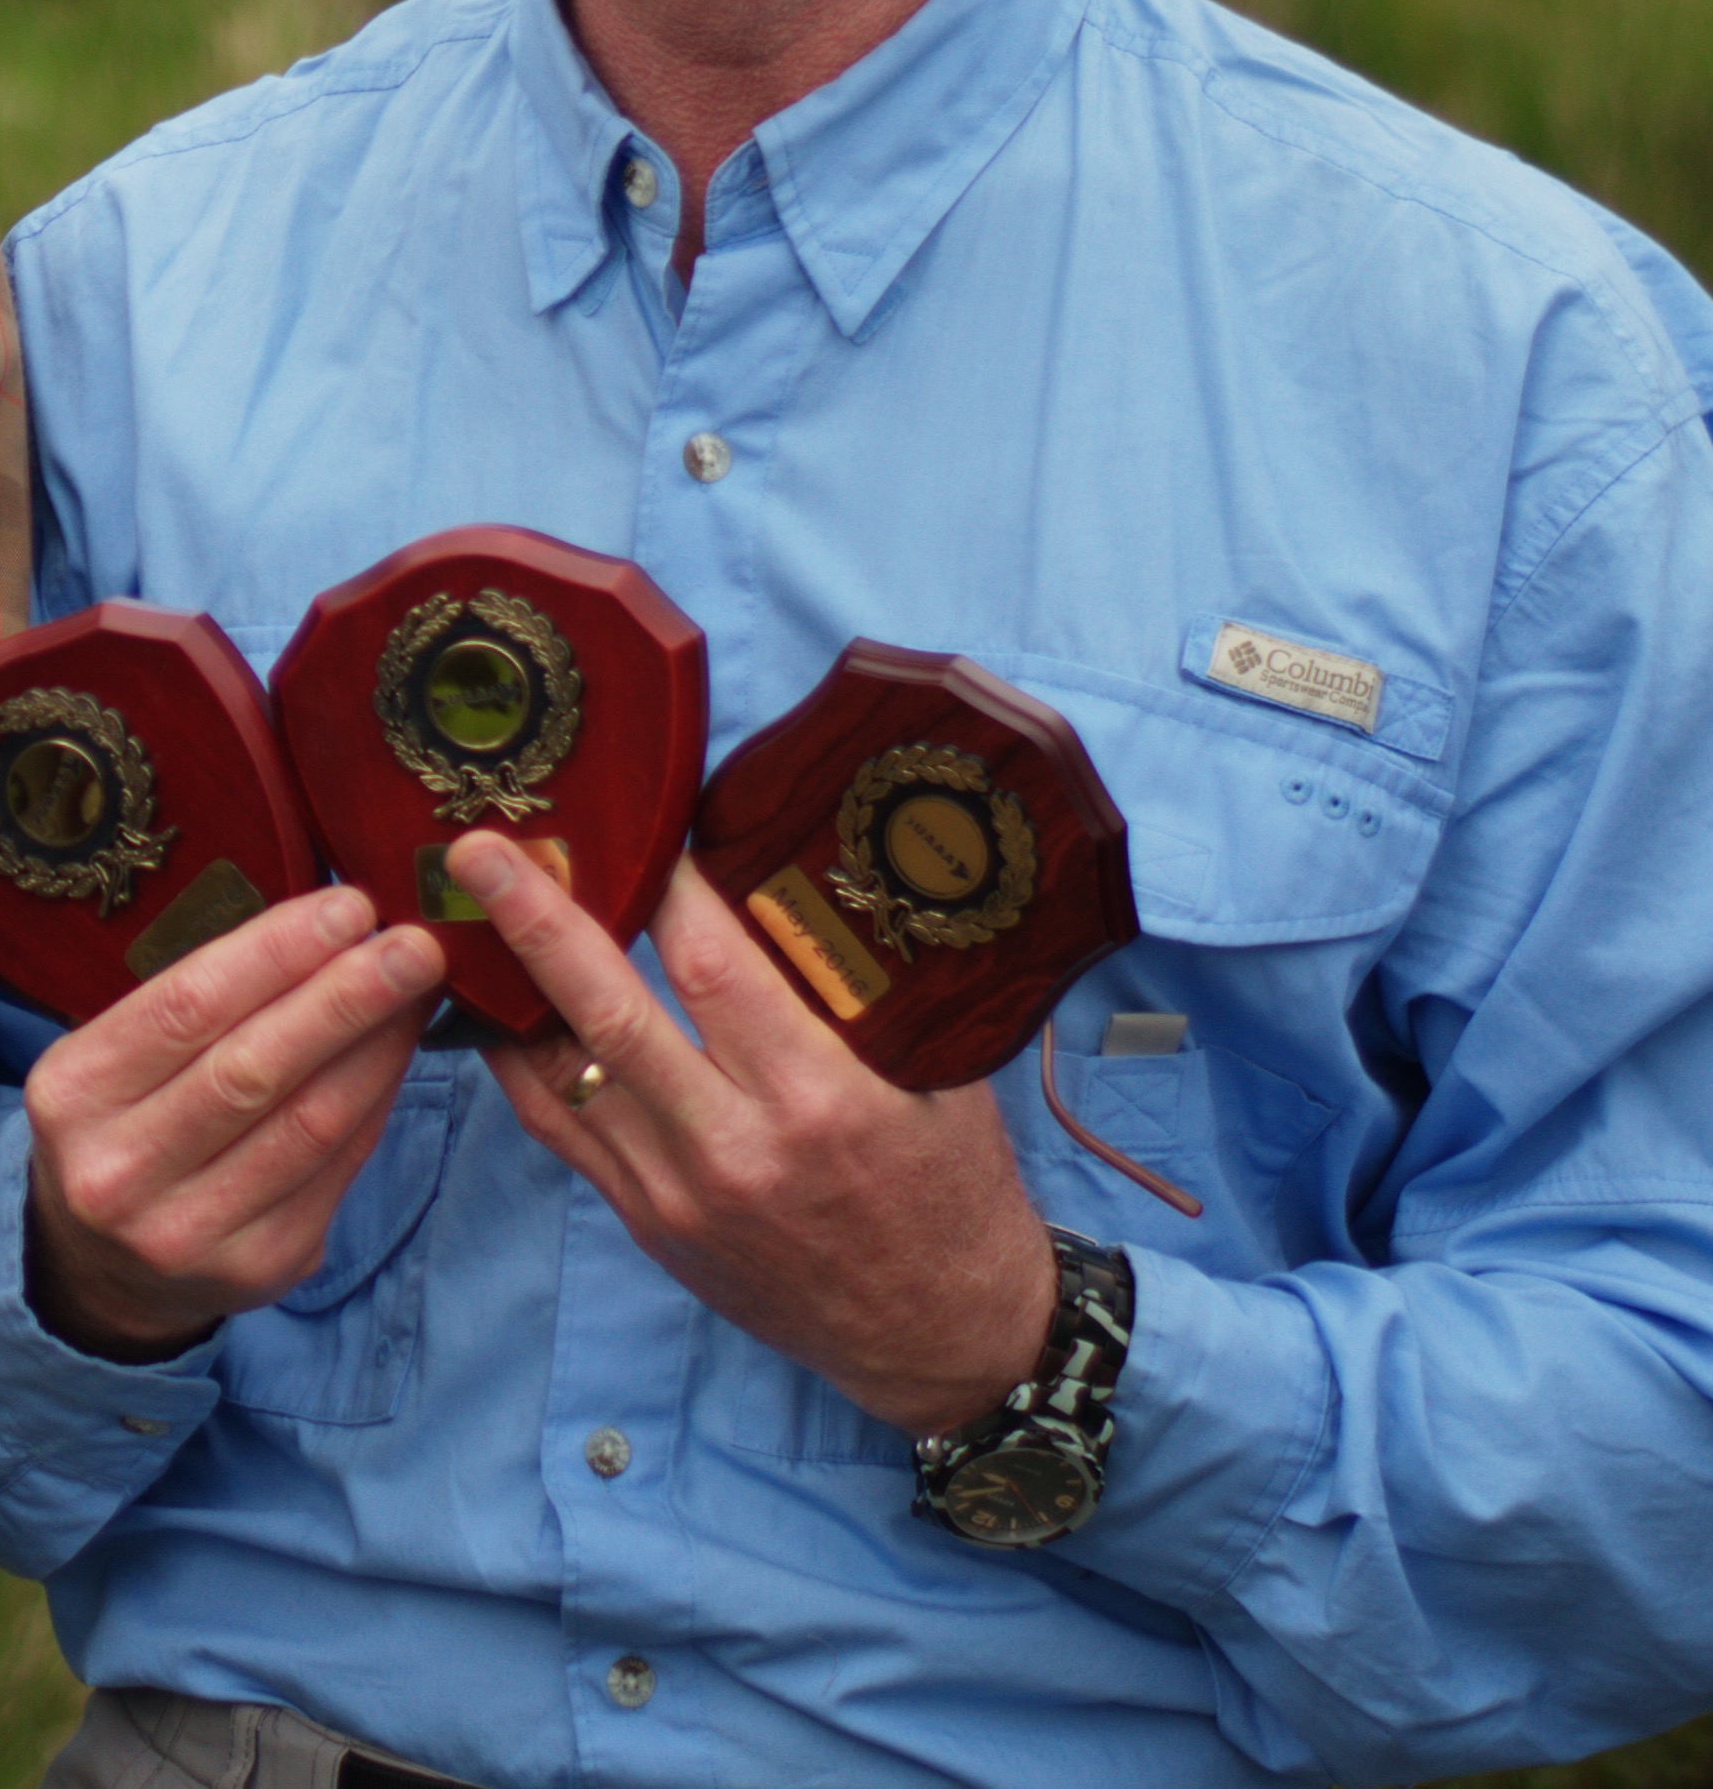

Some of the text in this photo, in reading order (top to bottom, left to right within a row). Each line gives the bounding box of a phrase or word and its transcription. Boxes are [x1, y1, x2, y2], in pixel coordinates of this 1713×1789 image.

[1259, 669, 1328, 700] Sportswear
[773, 886, 867, 997] May 2016
